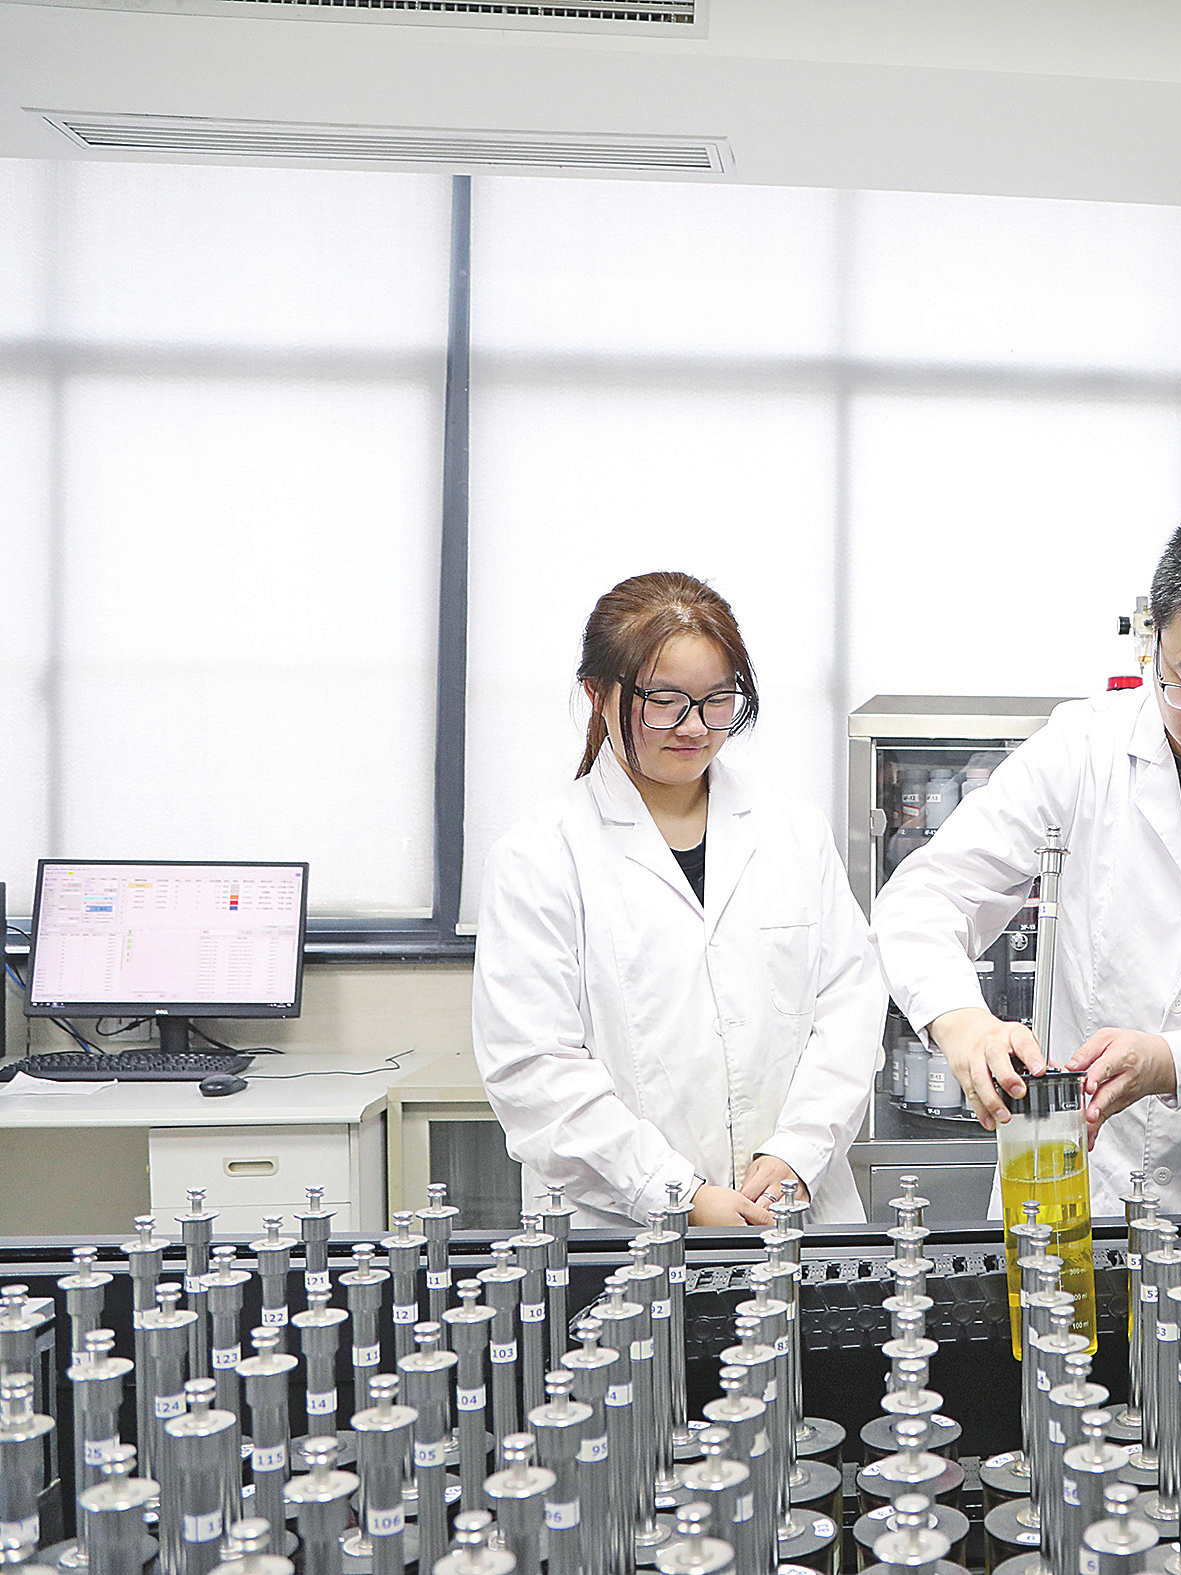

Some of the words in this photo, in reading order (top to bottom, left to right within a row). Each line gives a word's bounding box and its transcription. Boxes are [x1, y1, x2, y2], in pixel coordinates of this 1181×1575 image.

[670, 1270, 683, 1279] 91
[263, 1313, 284, 1323] 122
[1072, 1321, 1083, 1329] 100
[215, 1353, 238, 1365] 123
[492, 1348, 514, 1359] 103
[257, 1453, 283, 1466] 115
[373, 1515, 400, 1529] 106
